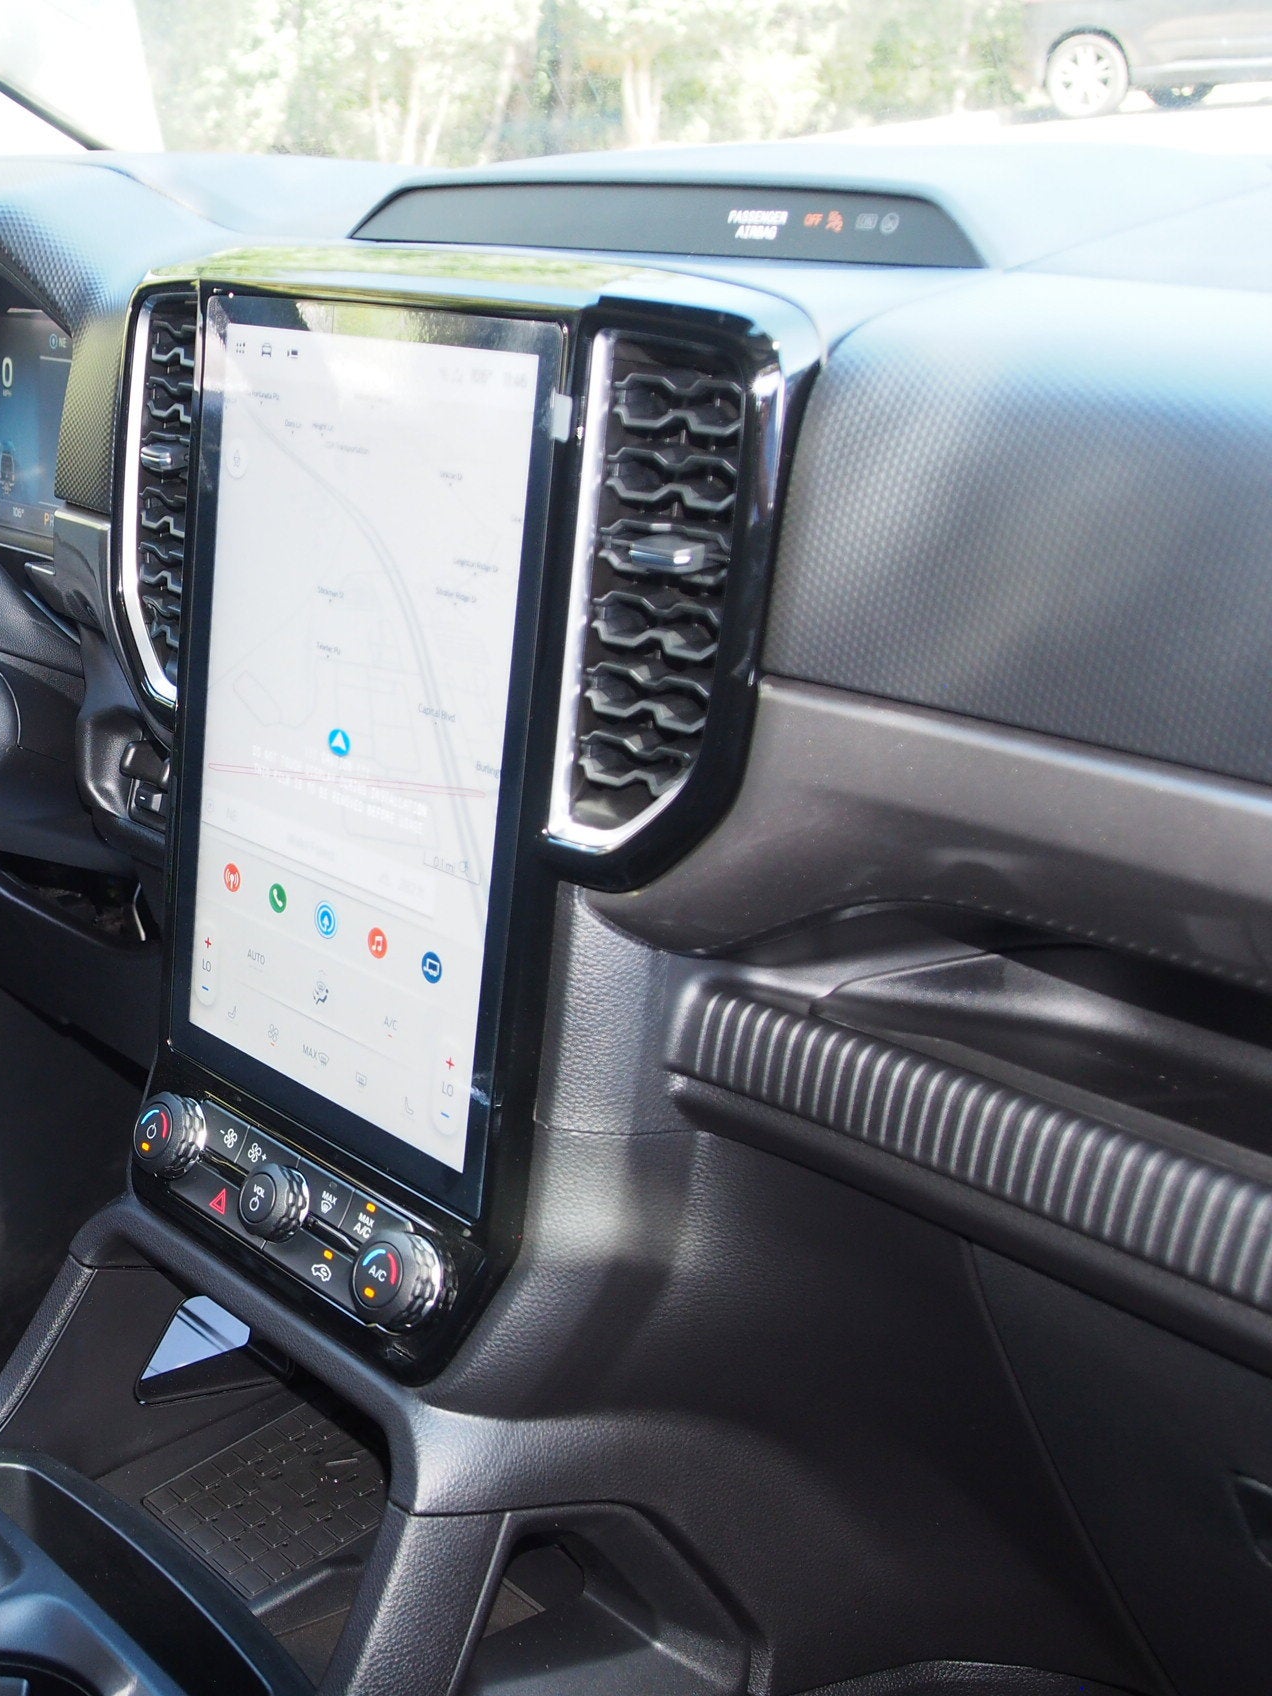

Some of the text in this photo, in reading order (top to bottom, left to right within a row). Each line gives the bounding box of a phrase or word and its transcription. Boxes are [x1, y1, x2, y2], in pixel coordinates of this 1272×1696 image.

[728, 210, 788, 225] PASSENGER
[804, 213, 823, 227] OFF
[735, 225, 778, 240] AIRBAG
[1, 356, 13, 389] 0
[44, 512, 50, 525] P
[418, 703, 456, 723] Capital Blvd
[247, 949, 266, 965] AUTO
[202, 958, 212, 973] LO
[384, 1016, 398, 1031] A/C
[302, 1044, 318, 1061] MAX
[441, 1082, 454, 1097] LO
[253, 1184, 265, 1199] VOL
[322, 1190, 338, 1206] MAX
[358, 1212, 375, 1228] MAX
[353, 1223, 372, 1239] A/C
[368, 1265, 387, 1282] A/C
